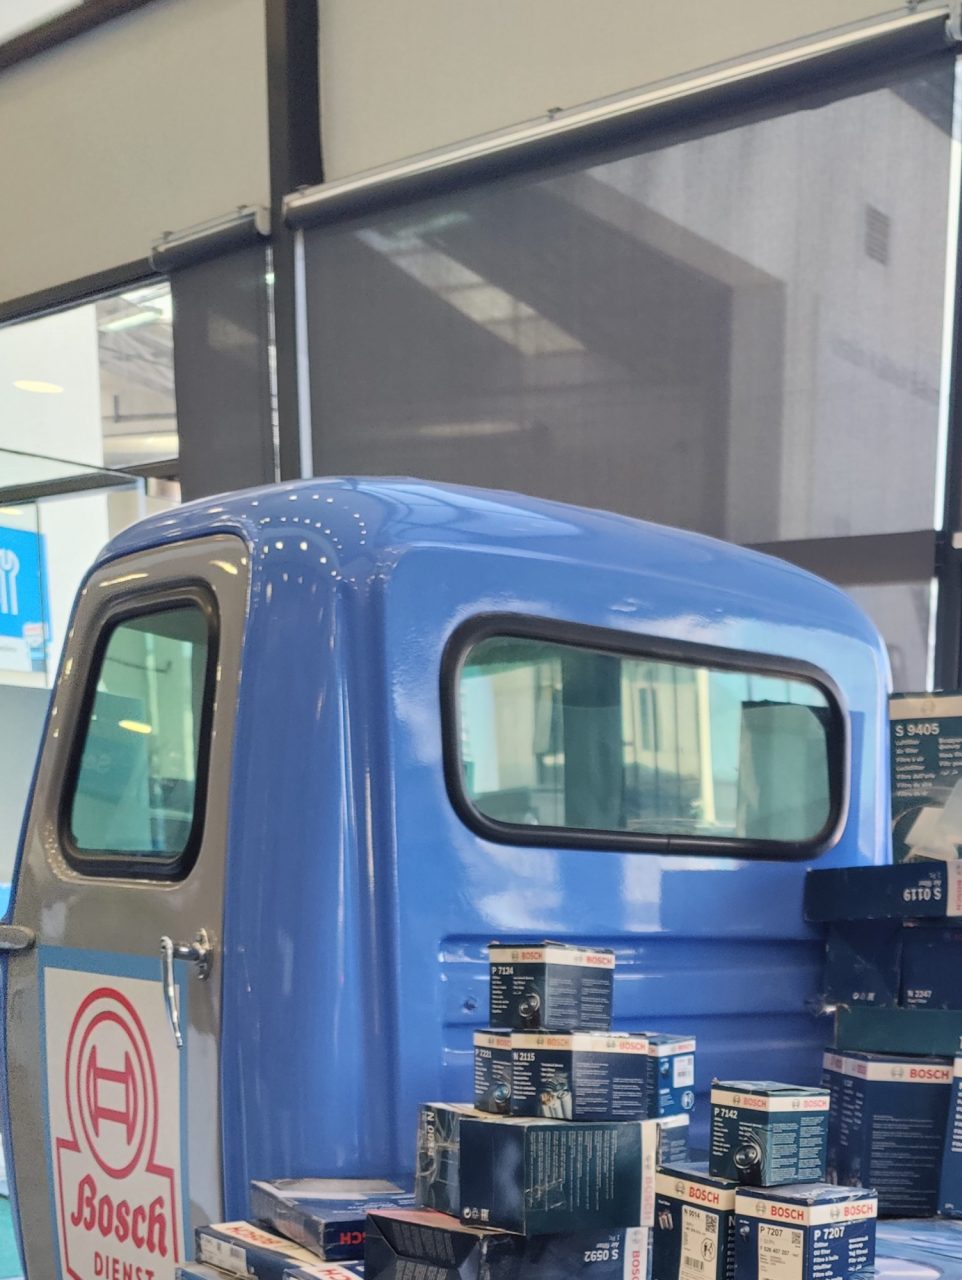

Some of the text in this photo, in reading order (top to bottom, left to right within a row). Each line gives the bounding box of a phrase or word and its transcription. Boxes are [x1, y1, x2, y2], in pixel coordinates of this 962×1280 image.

[895, 723, 940, 737] S 9405
[903, 888, 932, 902] 0119
[521, 951, 543, 961] BOSCH
[586, 956, 612, 965] BOSCH
[547, 1038, 570, 1047] BOSCH
[619, 1042, 646, 1051] BOSCH
[513, 1053, 536, 1061] N 2115
[909, 1068, 949, 1081] BOSCH
[743, 1097, 767, 1107] BOSCH
[714, 1107, 738, 1119] P 7142
[689, 1186, 720, 1205] BOSCH
[70, 1173, 168, 1258] Bosch
[770, 1206, 804, 1221] BOSCH
[844, 1204, 873, 1217] BOSCH
[760, 1226, 783, 1238] P 7207
[814, 1227, 845, 1241] P 7207
[584, 1250, 619, 1263] S 0592
